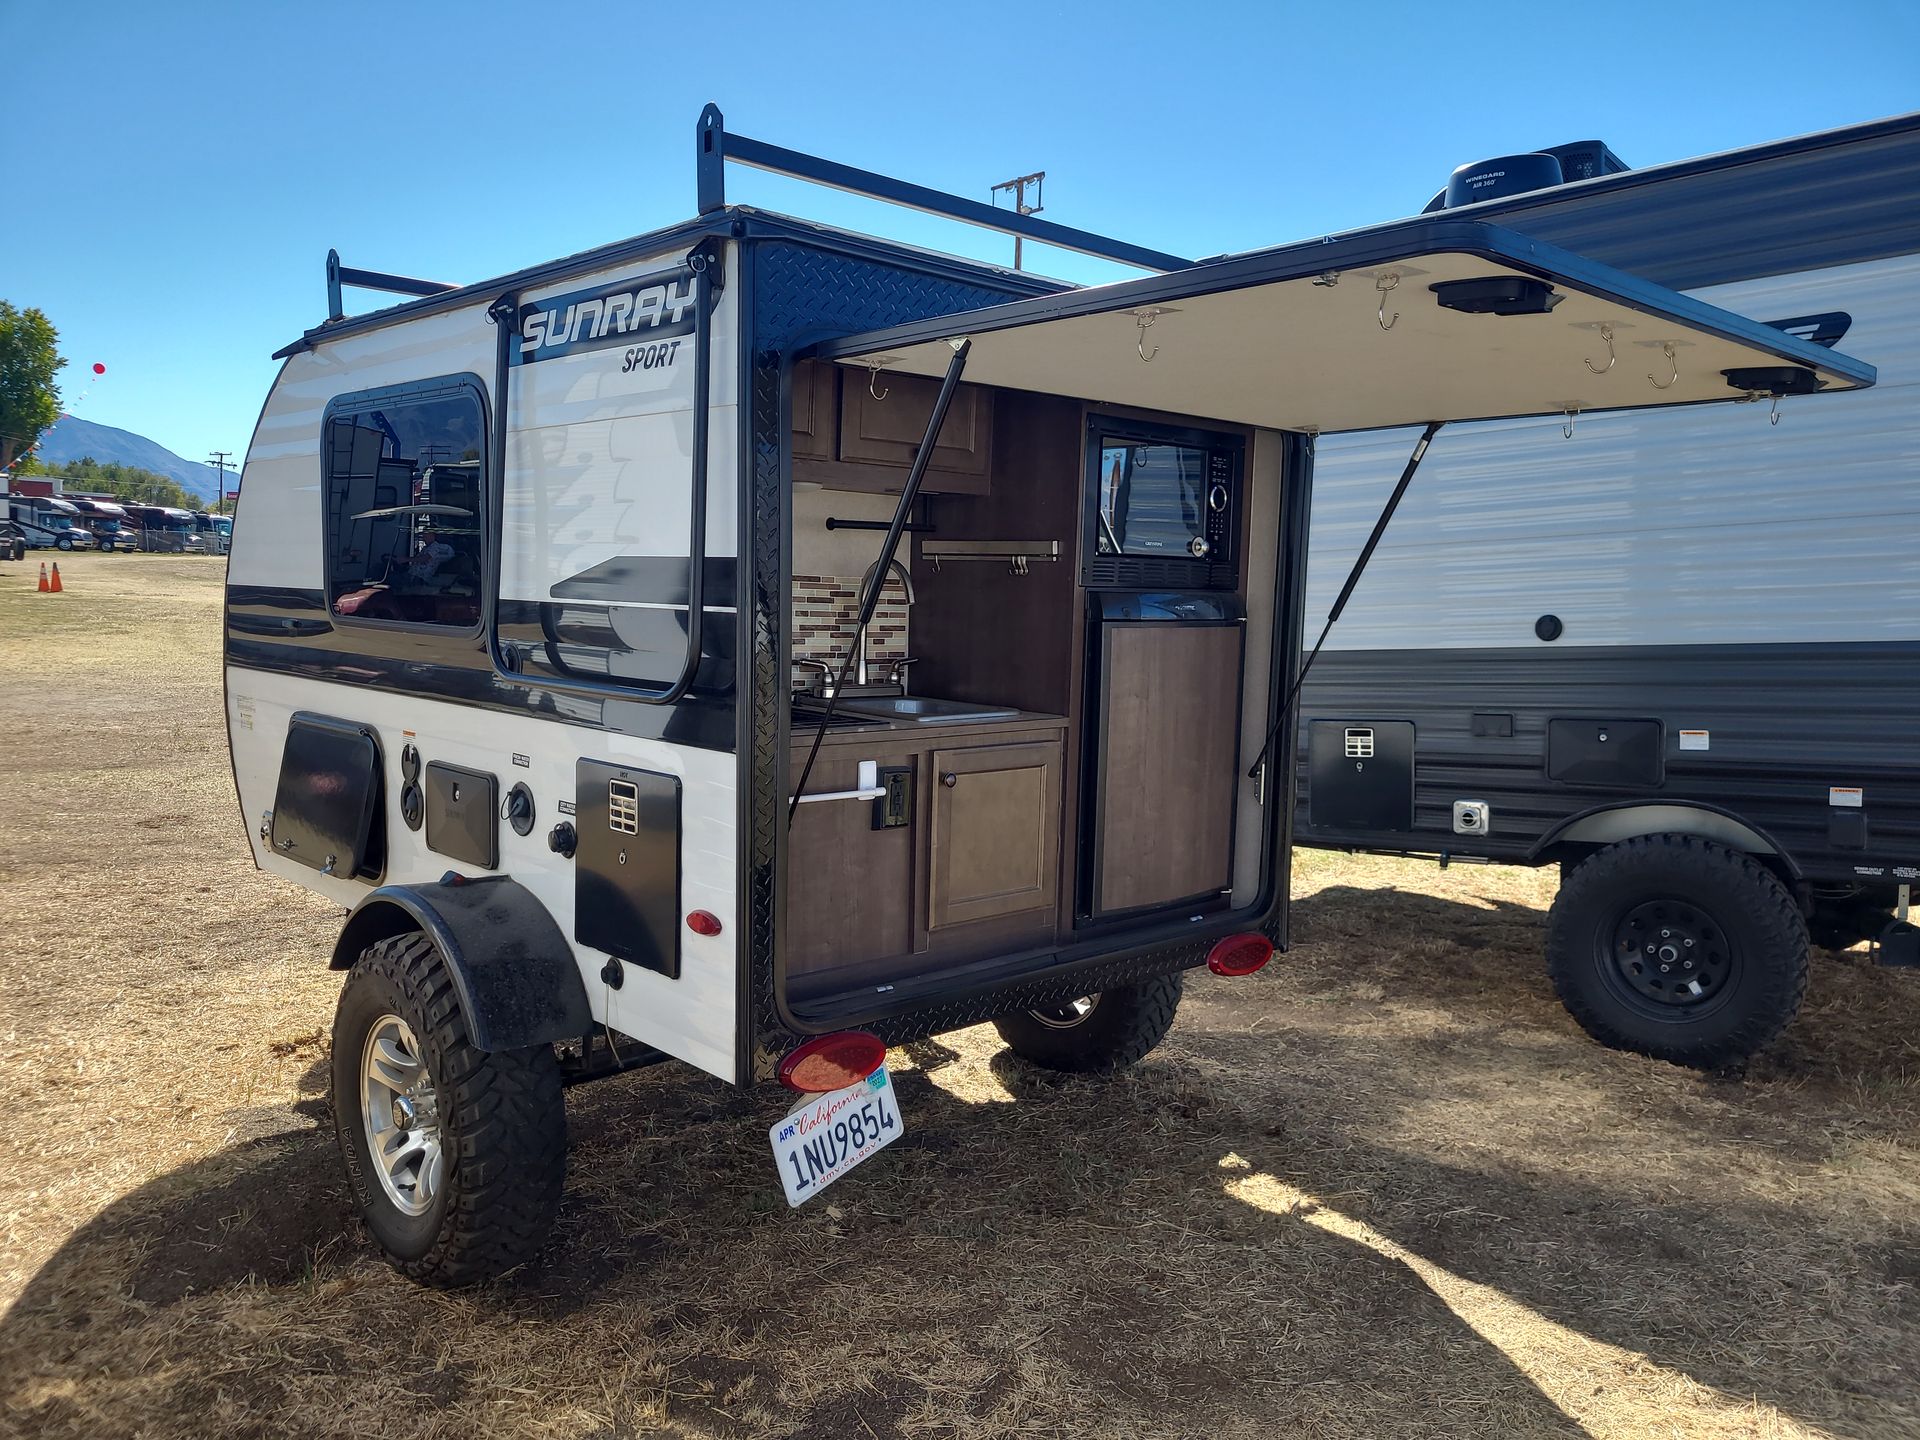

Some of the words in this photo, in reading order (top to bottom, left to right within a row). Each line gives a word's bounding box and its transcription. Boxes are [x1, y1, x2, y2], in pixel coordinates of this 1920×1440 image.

[1472, 181, 1483, 189] AIR
[520, 277, 697, 353] SUNRAY
[622, 340, 682, 374] SPORT
[779, 1125, 796, 1143] APR
[789, 1097, 894, 1192] 1NU9854
[819, 1141, 877, 1184] dmv.ca.gov
